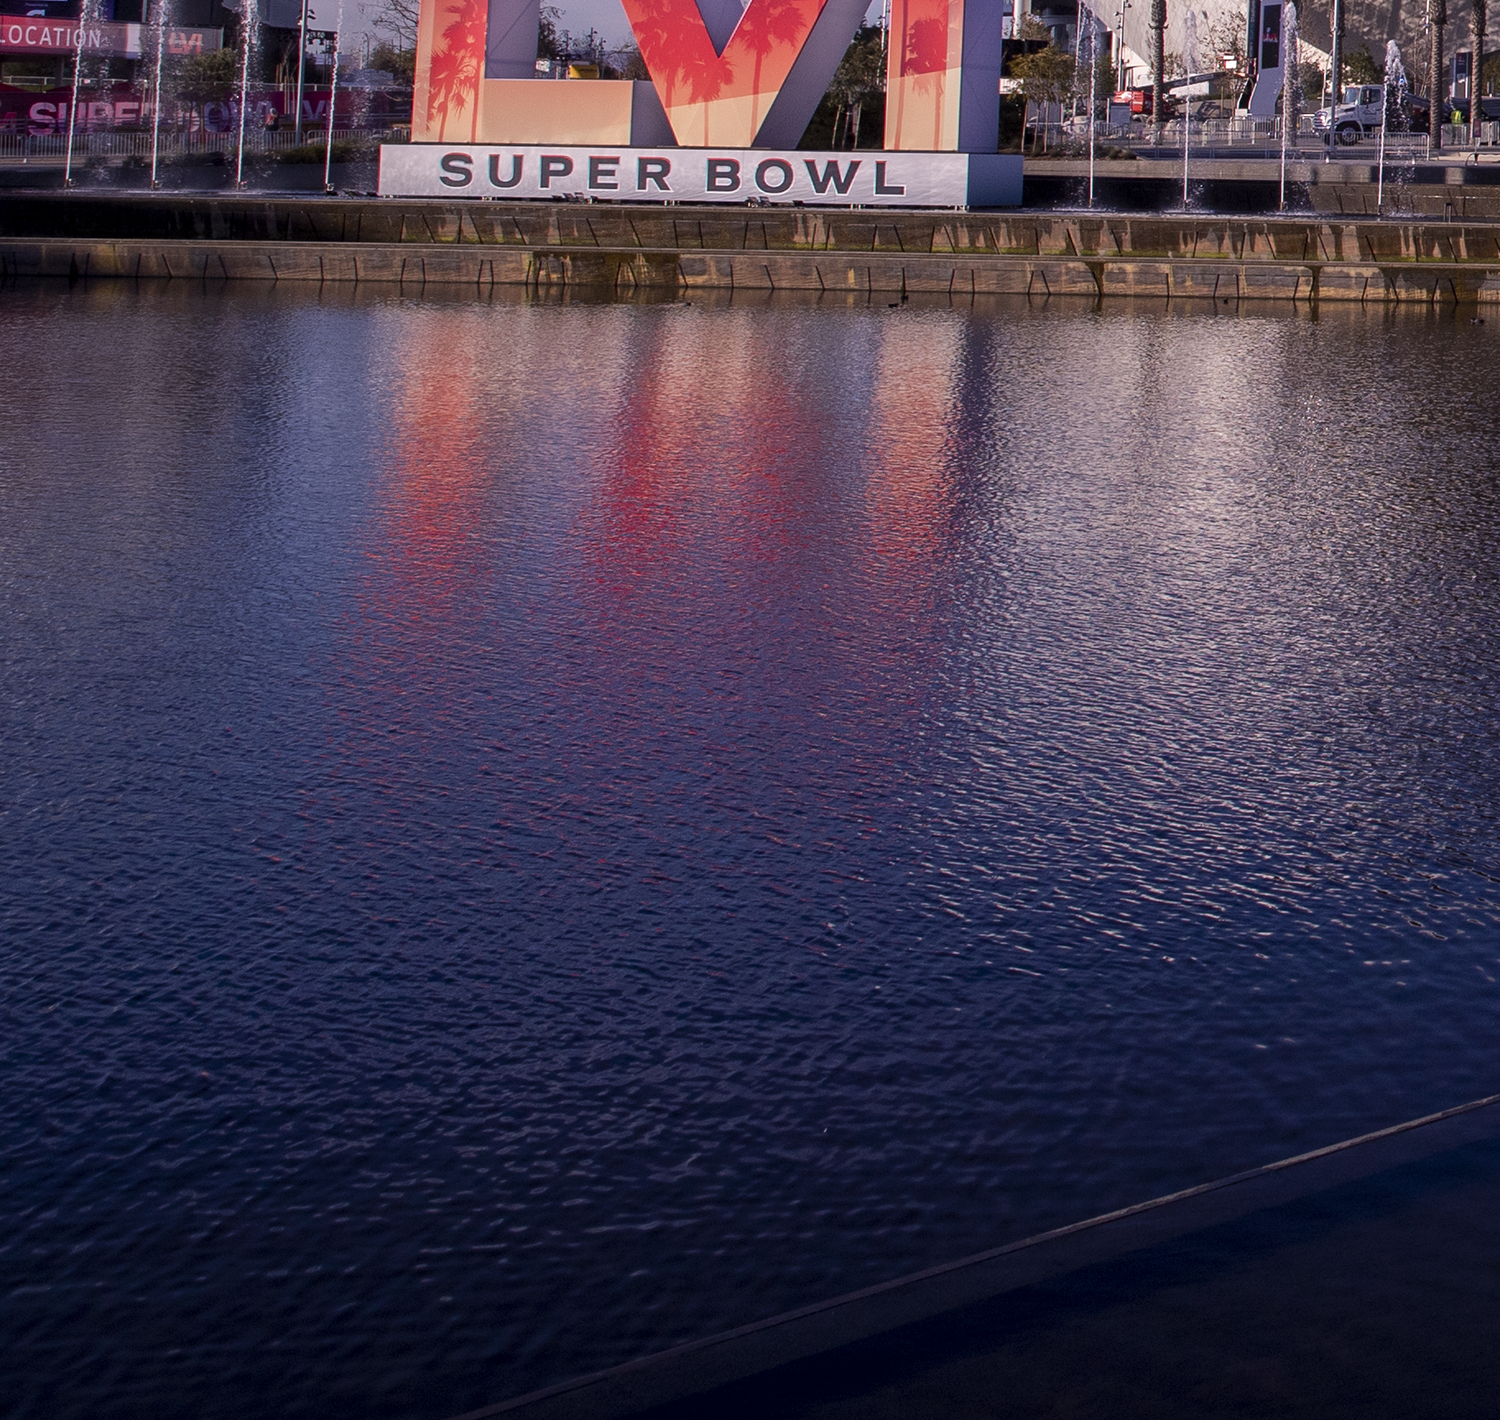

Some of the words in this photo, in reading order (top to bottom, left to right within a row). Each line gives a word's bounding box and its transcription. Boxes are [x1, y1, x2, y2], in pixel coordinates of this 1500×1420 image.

[0, 24, 102, 48] OCATION
[438, 152, 673, 194] SUPER
[705, 157, 908, 198] BOWL
